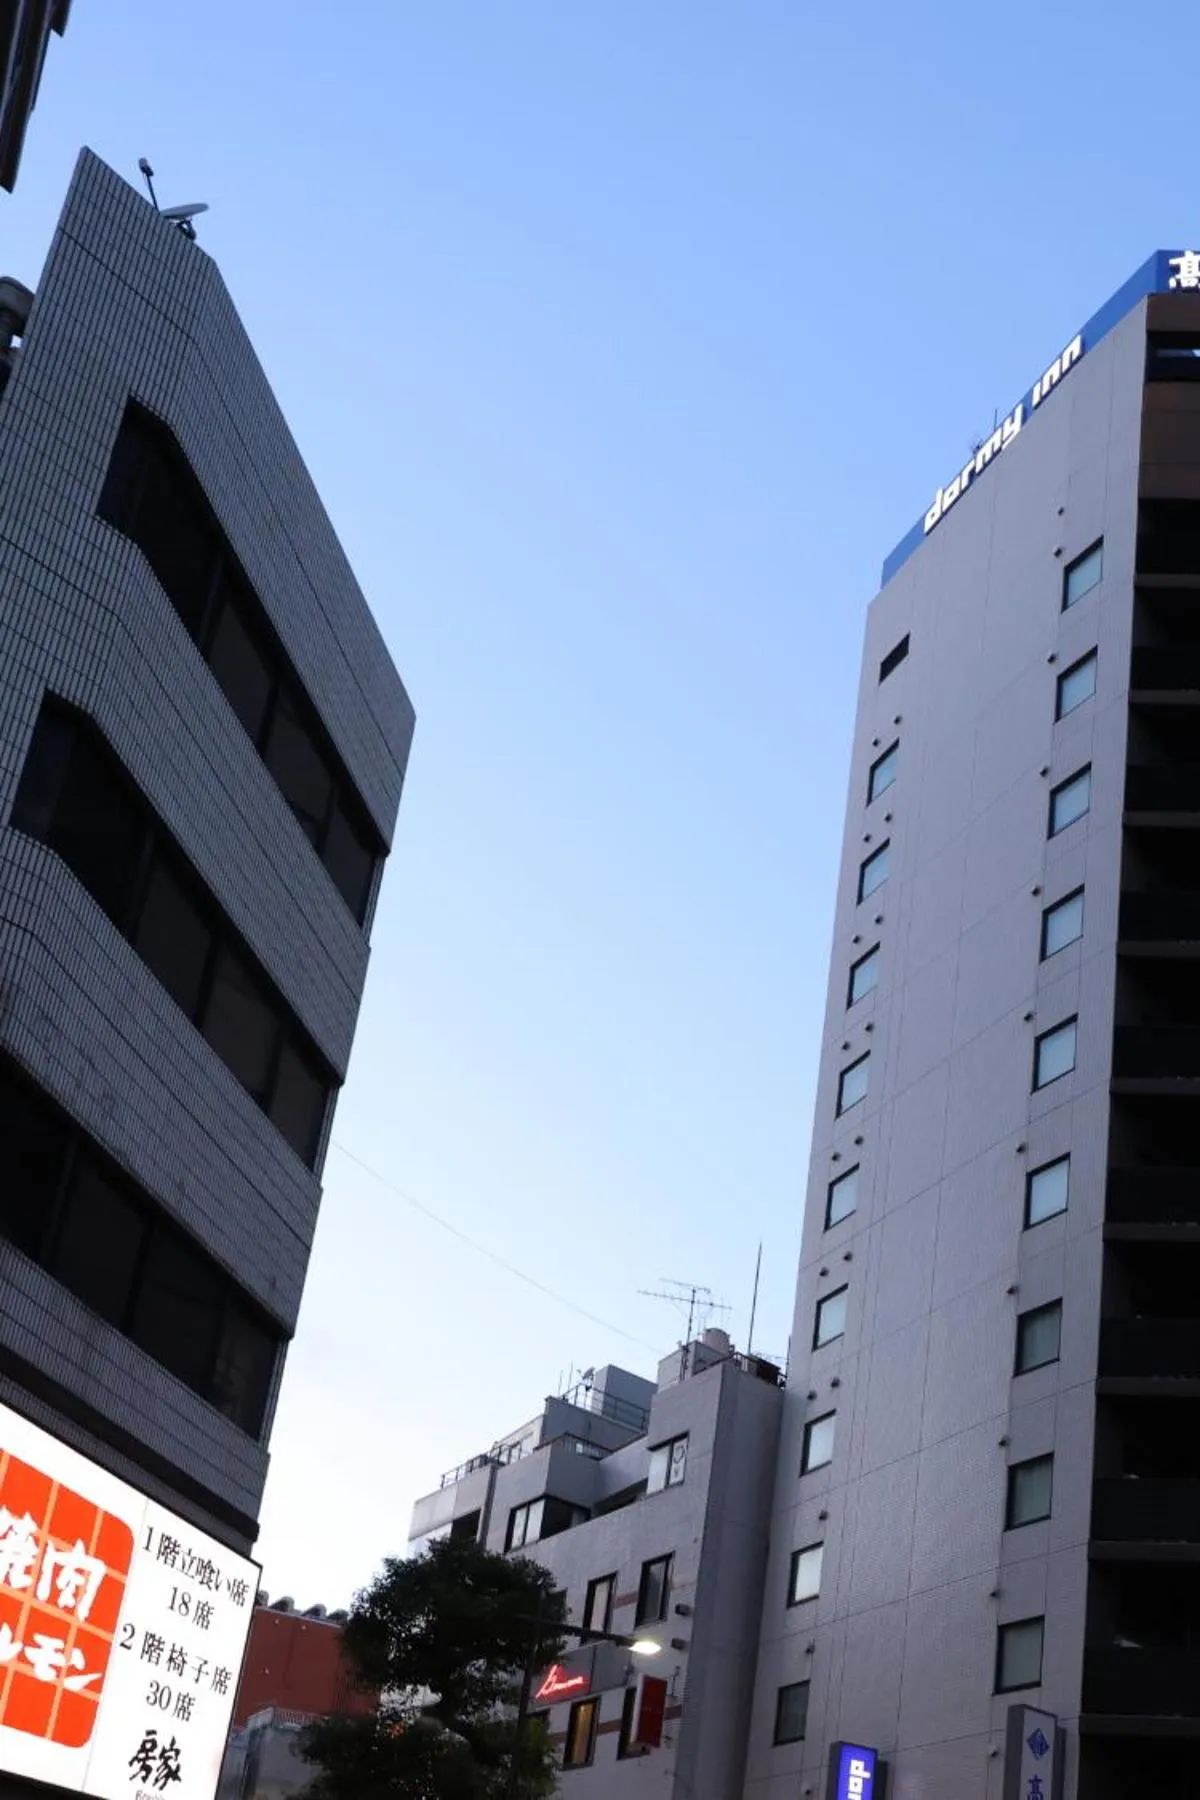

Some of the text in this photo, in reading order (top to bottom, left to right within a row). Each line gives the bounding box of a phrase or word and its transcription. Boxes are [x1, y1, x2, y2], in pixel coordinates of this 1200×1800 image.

[924, 334, 1082, 535] dormy inn
[168, 1586, 215, 1630] 18席
[119, 1623, 232, 1696] 2階椅子席
[146, 1680, 196, 1722] 30席
